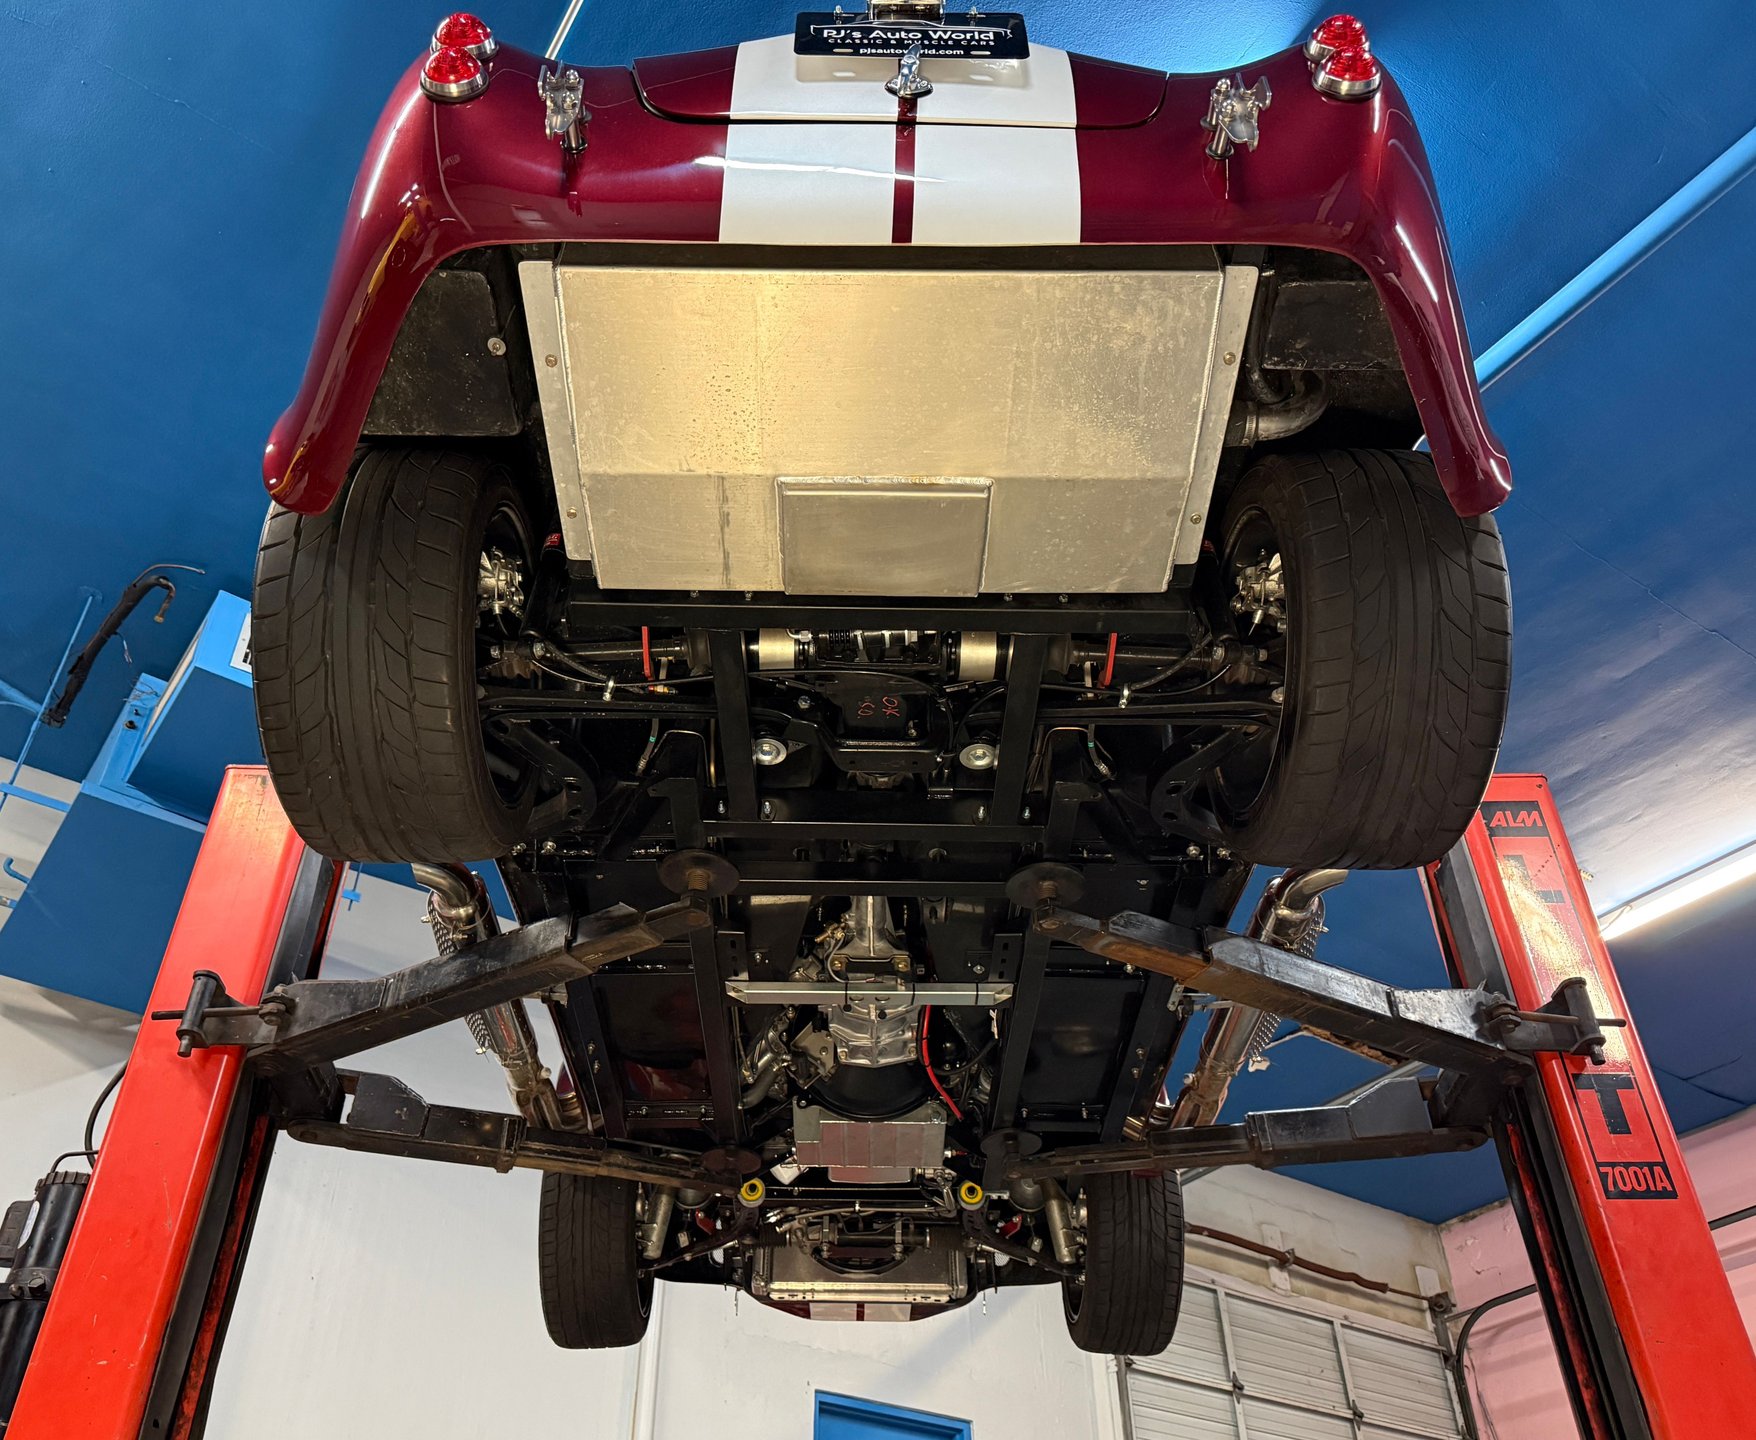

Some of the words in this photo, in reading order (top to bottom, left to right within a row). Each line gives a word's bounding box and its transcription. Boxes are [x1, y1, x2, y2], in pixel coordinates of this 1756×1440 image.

[868, 30, 922, 39] Auto
[928, 31, 995, 40] World
[859, 47, 964, 55] pjsautorld.com
[1489, 810, 1543, 828] ALM
[1599, 1166, 1673, 1192] 7001A
